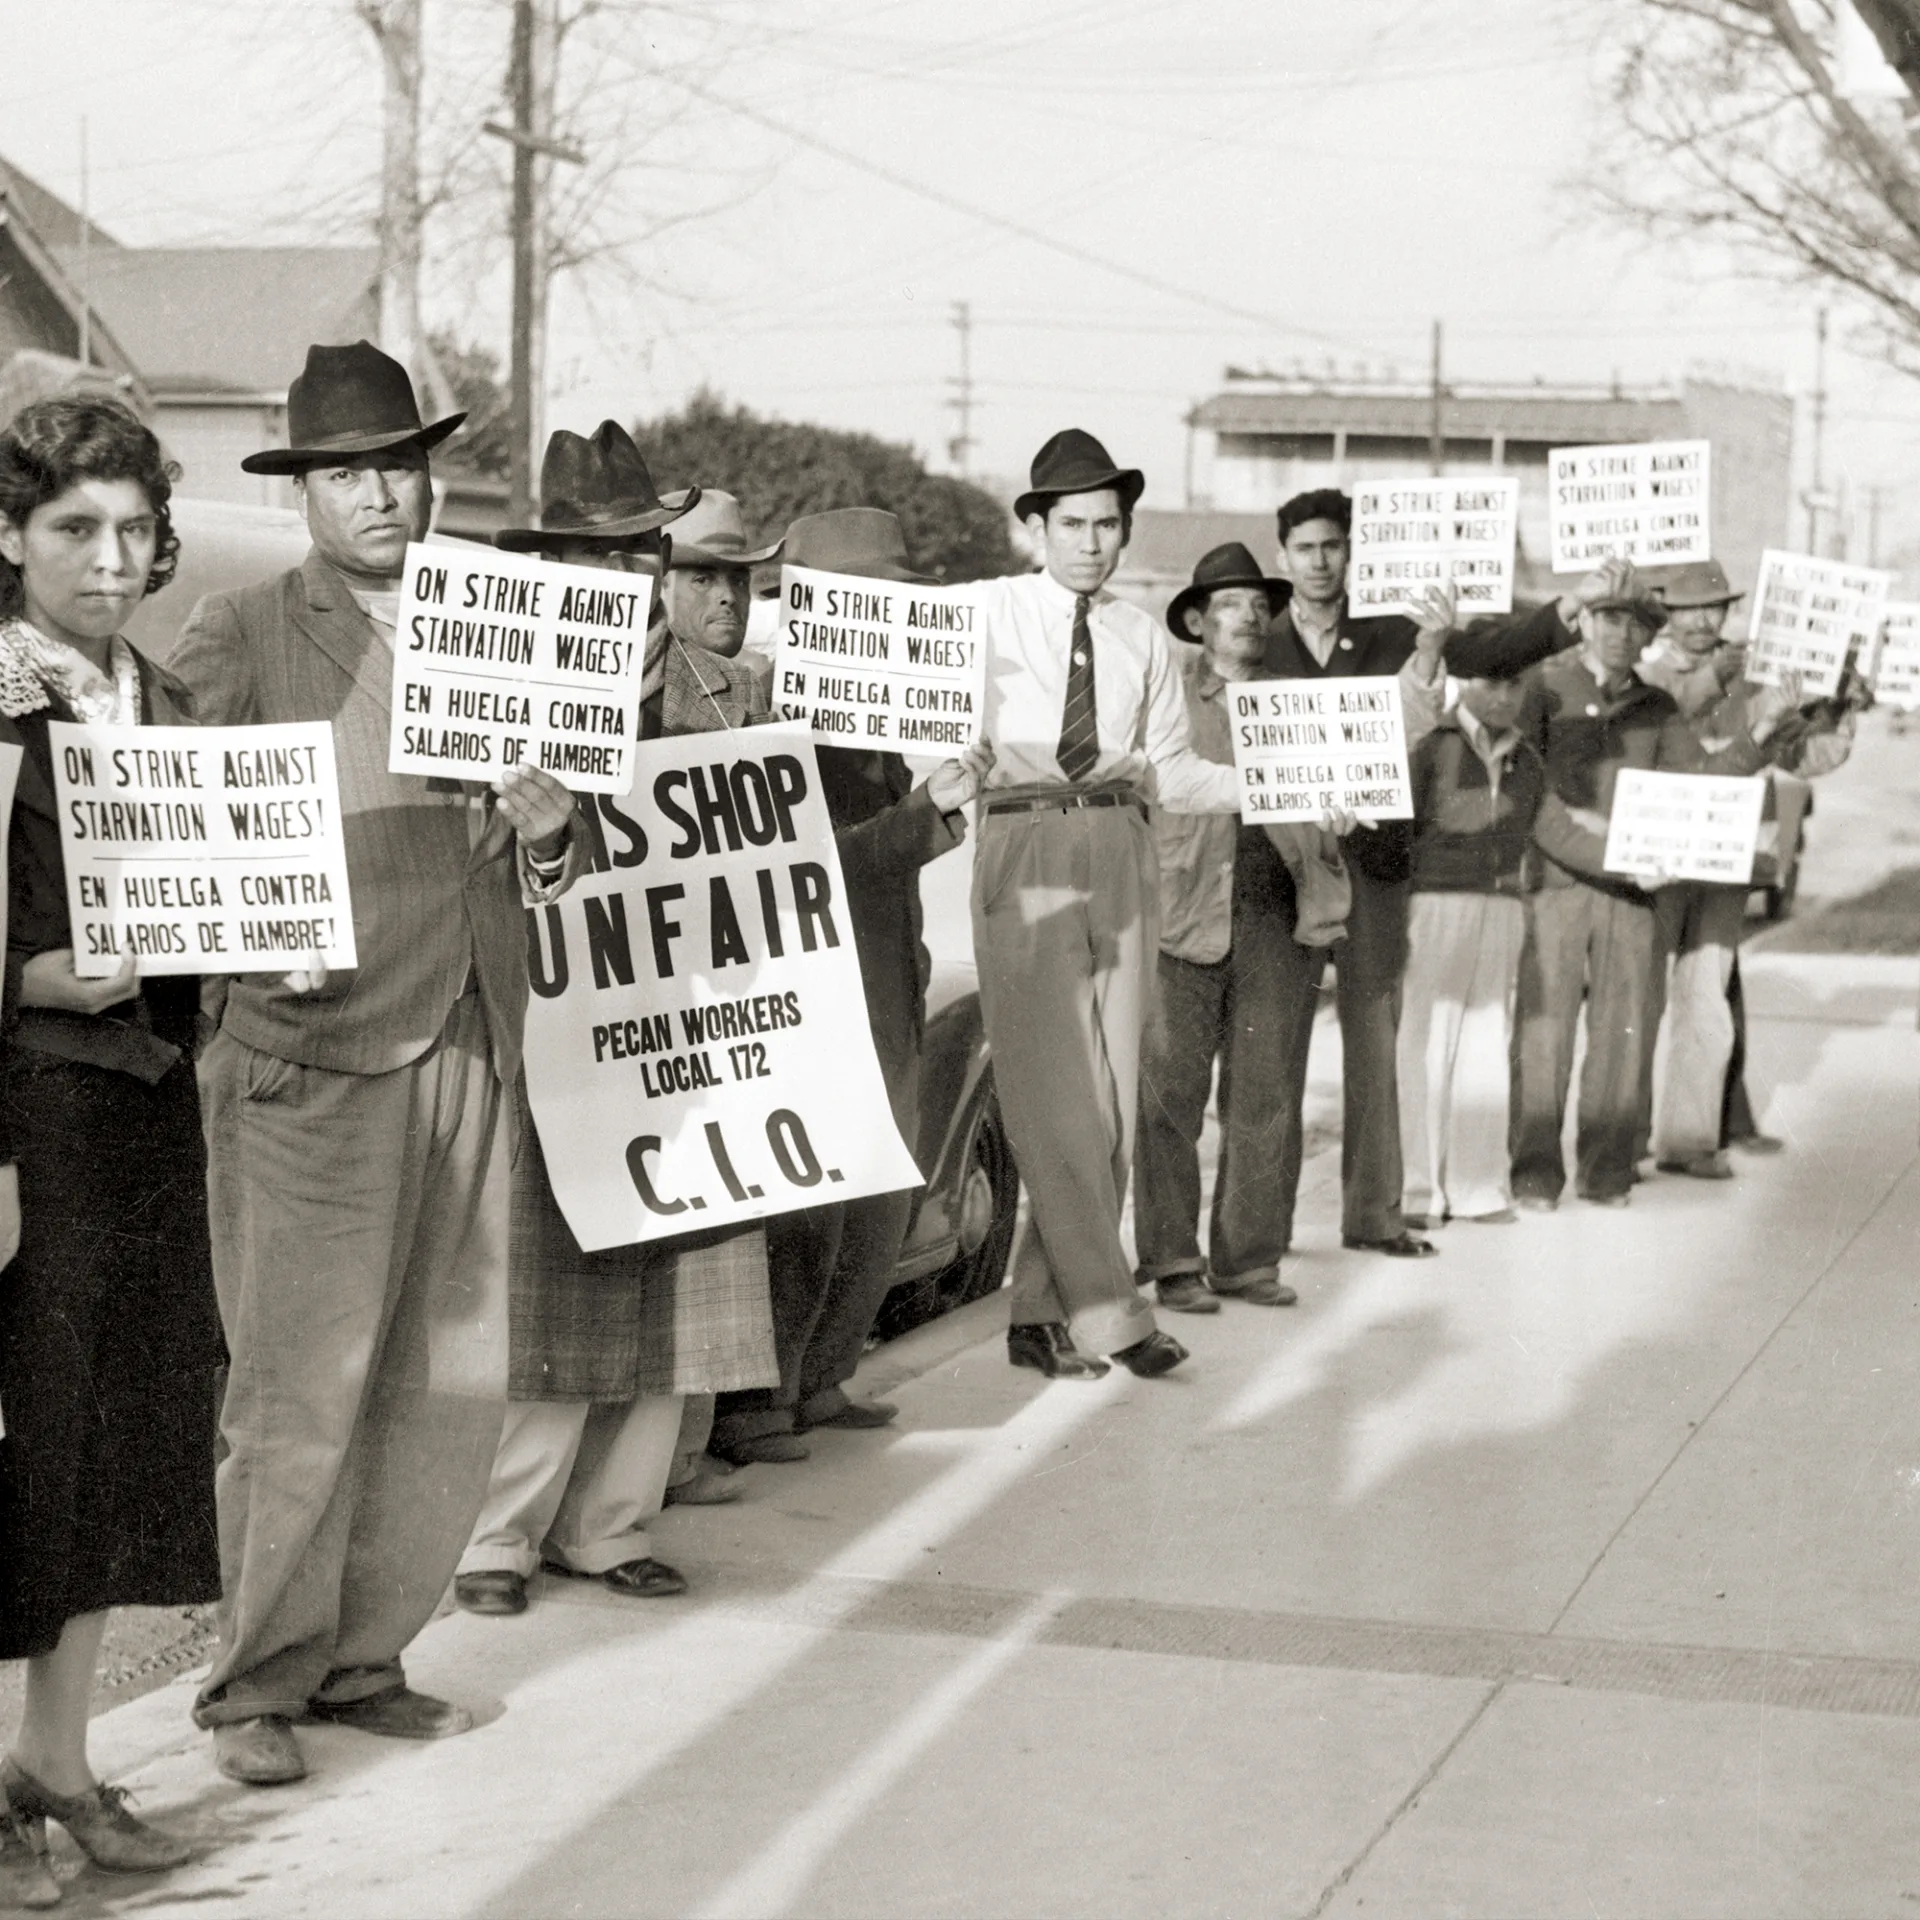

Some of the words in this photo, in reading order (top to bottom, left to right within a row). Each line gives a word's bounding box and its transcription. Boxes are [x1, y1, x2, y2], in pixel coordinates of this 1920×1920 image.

[415, 567, 448, 604] ON
[463, 573, 545, 617] STRIKE
[558, 586, 638, 629] AGAINST
[790, 582, 814, 613] ON
[826, 590, 893, 624] STRIKE
[907, 600, 976, 633] AGAINST
[409, 615, 535, 665] STARVATION
[555, 633, 632, 676] WAGES!
[788, 619, 889, 660] STARVATION
[907, 636, 975, 669] WAGES!
[405, 683, 431, 714] EN
[448, 688, 531, 726] HUELGA
[549, 701, 625, 736] CONTRA
[783, 671, 806, 696] EN
[818, 676, 891, 706] HUELGA
[905, 687, 973, 714] CONTRA
[1237, 695, 1260, 717] ON
[1270, 692, 1326, 716] STRIKE
[1339, 690, 1392, 713] AGAINST
[403, 726, 491, 763] SALARIOS
[503, 737, 527, 766] DE
[540, 741, 622, 777] HAMBRE!
[867, 714, 888, 737] DE
[899, 717, 972, 745] HAMBRE!
[1241, 722, 1327, 748] STARVATION
[1341, 720, 1395, 744] WAGES!
[64, 746, 95, 787] ON
[113, 750, 203, 788] STRIKE
[224, 746, 317, 788] AGAINST
[1245, 766, 1266, 786] EN
[1276, 765, 1335, 785] HUELGA
[1346, 762, 1400, 782] CONTRA
[71, 800, 207, 841] STARVATION
[227, 799, 325, 841] WAGES!
[570, 790, 649, 874] IS
[653, 754, 808, 859] SHOP
[1249, 791, 1312, 812] SALARIOS
[1319, 791, 1335, 809] DE
[79, 876, 107, 908] EN
[125, 876, 223, 908] HUELGA
[240, 873, 332, 906] CONTRA
[85, 922, 186, 956] SALARIOS
[200, 922, 228, 953] DE
[240, 917, 337, 951] HAMBRE!
[525, 861, 841, 999] UNFAIR
[592, 1013, 673, 1062] PECAN
[681, 991, 802, 1046] WORKERS
[640, 1053, 723, 1098] LOCAL
[728, 1042, 771, 1081] 172
[625, 1108, 846, 1216] C.I.O.
